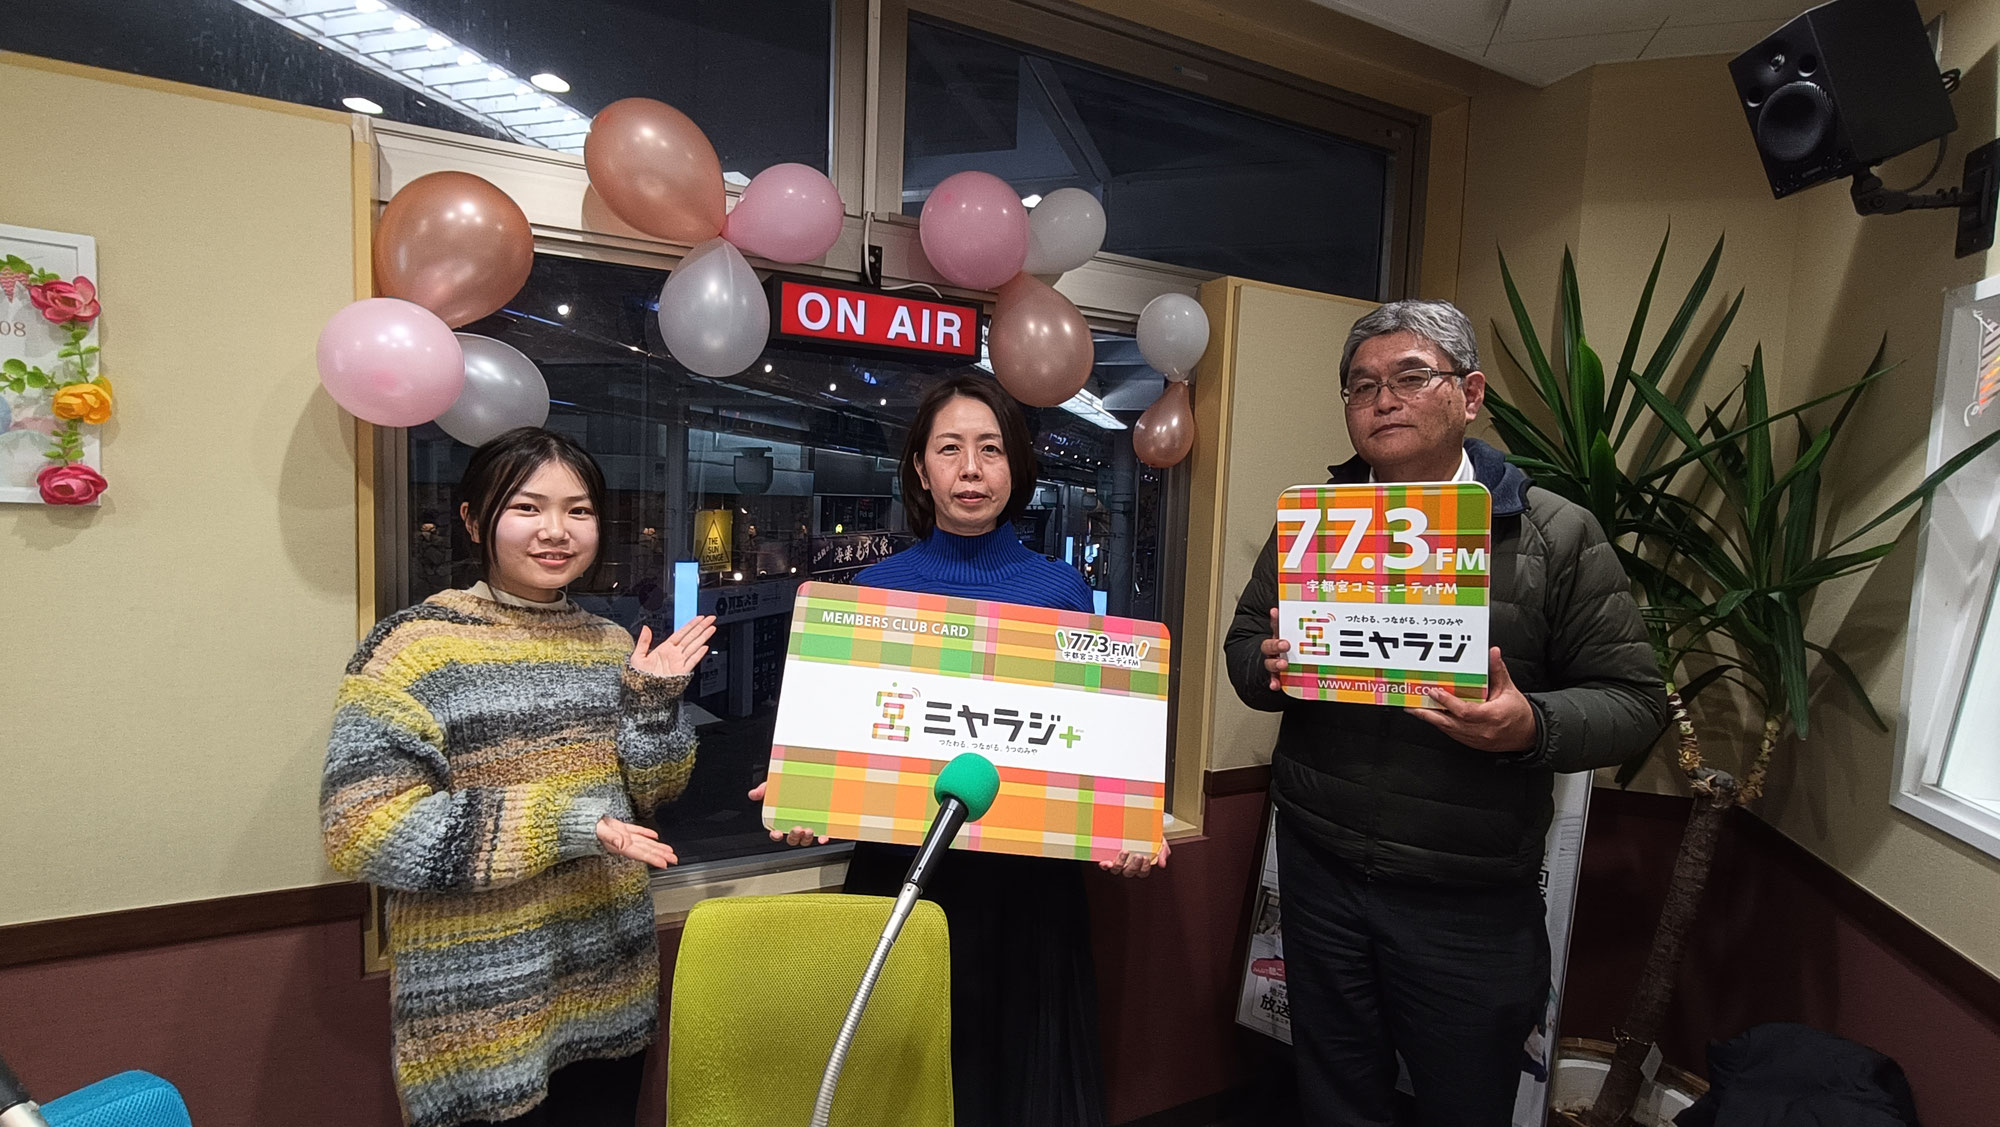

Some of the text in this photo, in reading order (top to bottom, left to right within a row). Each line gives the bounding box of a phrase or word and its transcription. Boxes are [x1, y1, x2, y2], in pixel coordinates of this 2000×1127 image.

[797, 291, 962, 348] ON AIR
[707, 537, 719, 545] THE
[707, 546, 720, 554] SUN
[1276, 506, 1486, 571] 77.3 FM
[702, 554, 724, 563] LOUNGE
[1305, 579, 1459, 596] 宇都宮コミュニティFM
[821, 610, 970, 639] MEMBERS CLUB CARD
[1070, 632, 1135, 658] 77.3 FM
[1339, 629, 1472, 664] ミヤラジ
